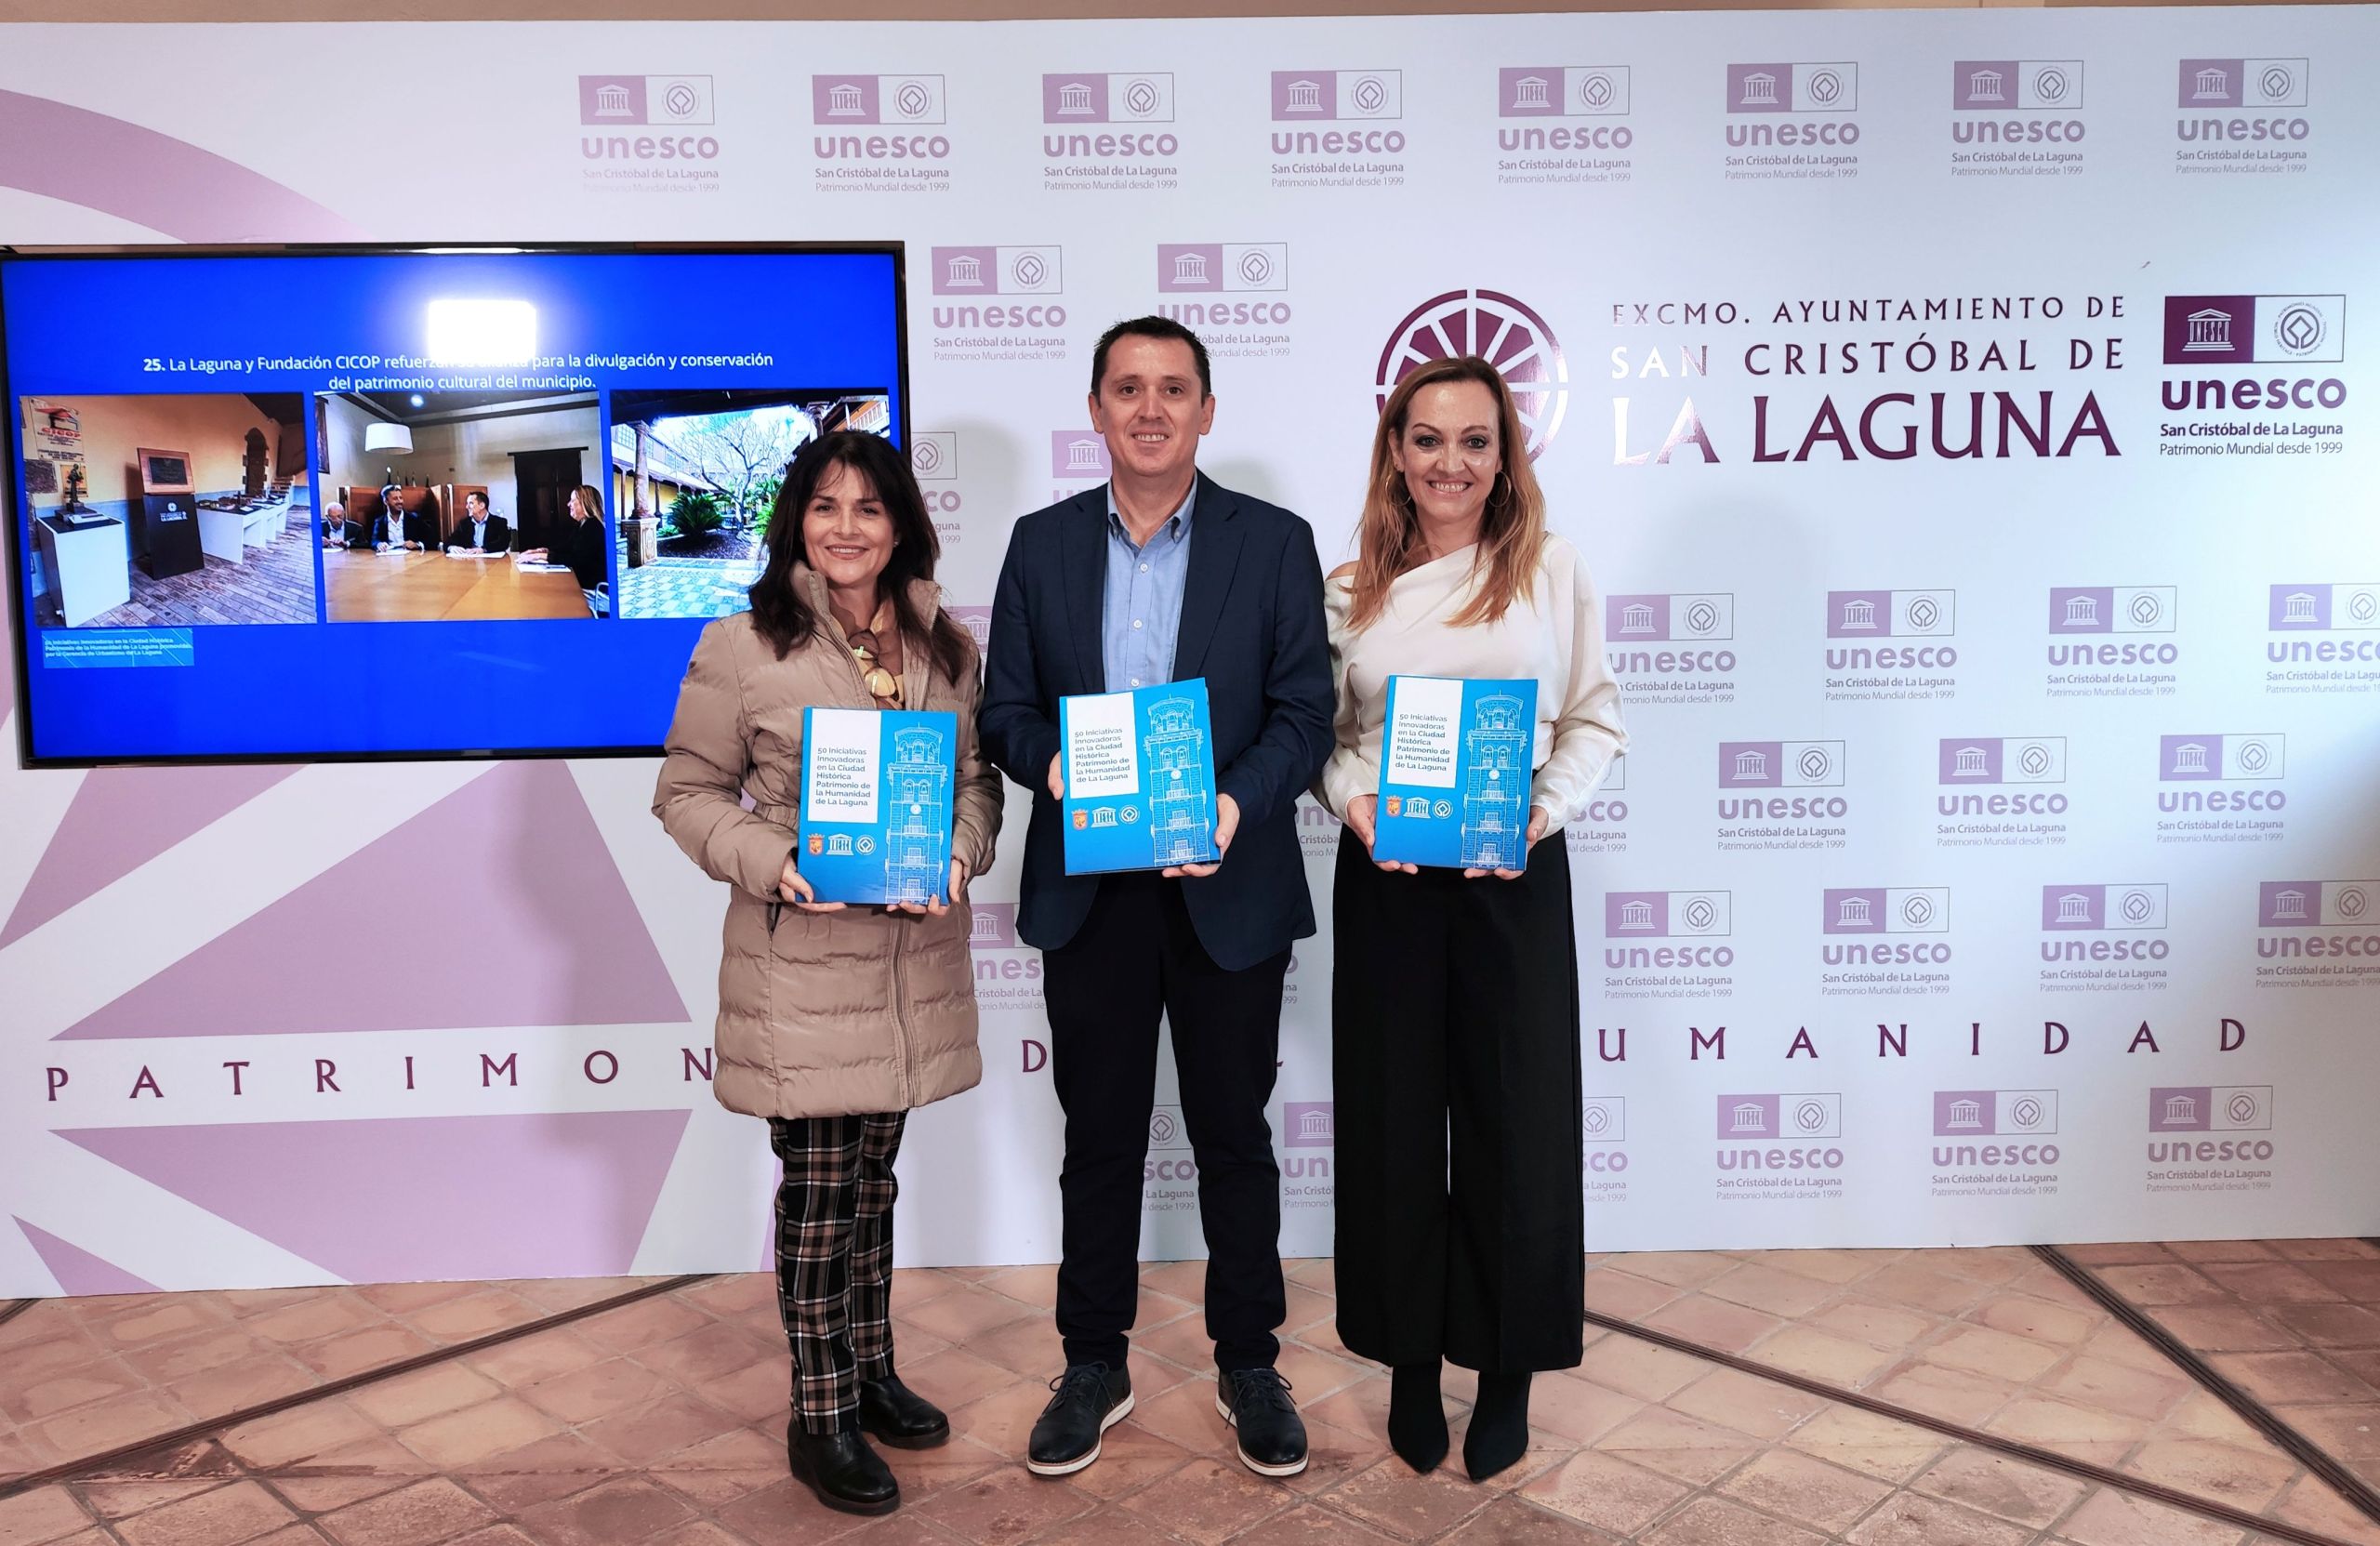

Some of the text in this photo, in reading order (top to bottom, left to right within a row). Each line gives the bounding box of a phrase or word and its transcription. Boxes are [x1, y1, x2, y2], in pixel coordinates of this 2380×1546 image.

[1499, 126, 1633, 151] unesco
[1726, 123, 1859, 147] unesco
[1953, 121, 2085, 143] unesco
[2177, 118, 2309, 141] unesco
[582, 137, 719, 159] unesco
[814, 136, 950, 159] unesco
[1044, 134, 1178, 157] unesco
[1272, 131, 1405, 154] unesco
[1044, 166, 1177, 177] San Cristóbal de La Laguna
[1045, 181, 1091, 190] Patrimonio
[1093, 180, 1127, 190] Mundial
[1129, 180, 1153, 189] desde
[933, 306, 1066, 328] unesco
[1158, 302, 1290, 325] unesco
[1613, 297, 2124, 326] EXCMO. AYUNTAMIENTO DE
[2189, 321, 2229, 342] UNESCO
[143, 359, 165, 371] 25.
[169, 358, 186, 371] La
[190, 358, 242, 374] Laguna
[245, 360, 254, 373] y
[258, 356, 331, 370] Fundación
[336, 356, 380, 369] CICOP
[533, 356, 564, 370] para
[569, 354, 580, 367] la
[585, 353, 665, 370] divulgación
[668, 356, 676, 370] y
[681, 353, 773, 366] conservación
[1611, 333, 2123, 378] SAN CRISTÓBAL DE
[329, 375, 596, 392] del patrimonio cultural del municipio.
[2162, 378, 2347, 410] unesco
[1612, 390, 2122, 465] LA LAGUNA
[2161, 422, 2343, 438] San Cristóbal de La Laguna
[2161, 442, 2342, 456] Patrimonio Mundial desde 1999
[1609, 651, 1736, 674] unesco
[1827, 647, 1957, 669] unesco
[2048, 643, 2178, 666] unesco
[2268, 641, 2380, 663] unesc
[1826, 677, 1954, 688] San Cristóbal de La Laguna
[1826, 693, 1870, 701] Patrimonio
[1908, 691, 1932, 699] desde
[1399, 721, 1445, 730] Innovadoras
[1397, 746, 1438, 754] Patrimonio
[1405, 754, 1449, 762] Humanidad
[1077, 759, 1117, 767] Patrimonio
[1085, 765, 1130, 773] Humanidad
[1418, 763, 1447, 772] Laguna
[1719, 798, 1847, 819] unesco
[1938, 794, 2068, 816] unesco
[2159, 790, 2286, 813] unesco
[1606, 946, 1734, 969] unesco
[1823, 944, 1951, 965] unesco
[2042, 940, 2169, 961] unesco
[2257, 936, 2380, 958] unesco
[46, 1047, 713, 1102] PATRIMON
[1598, 1018, 2245, 1062] UMANIDAD
[1717, 1148, 1844, 1170] unesco
[1933, 1144, 2059, 1167] unesco
[2149, 1140, 2273, 1162] unesco
[1716, 1177, 1842, 1187] San Cristóbal de La Laguna
[1797, 1190, 1820, 1198] desde
